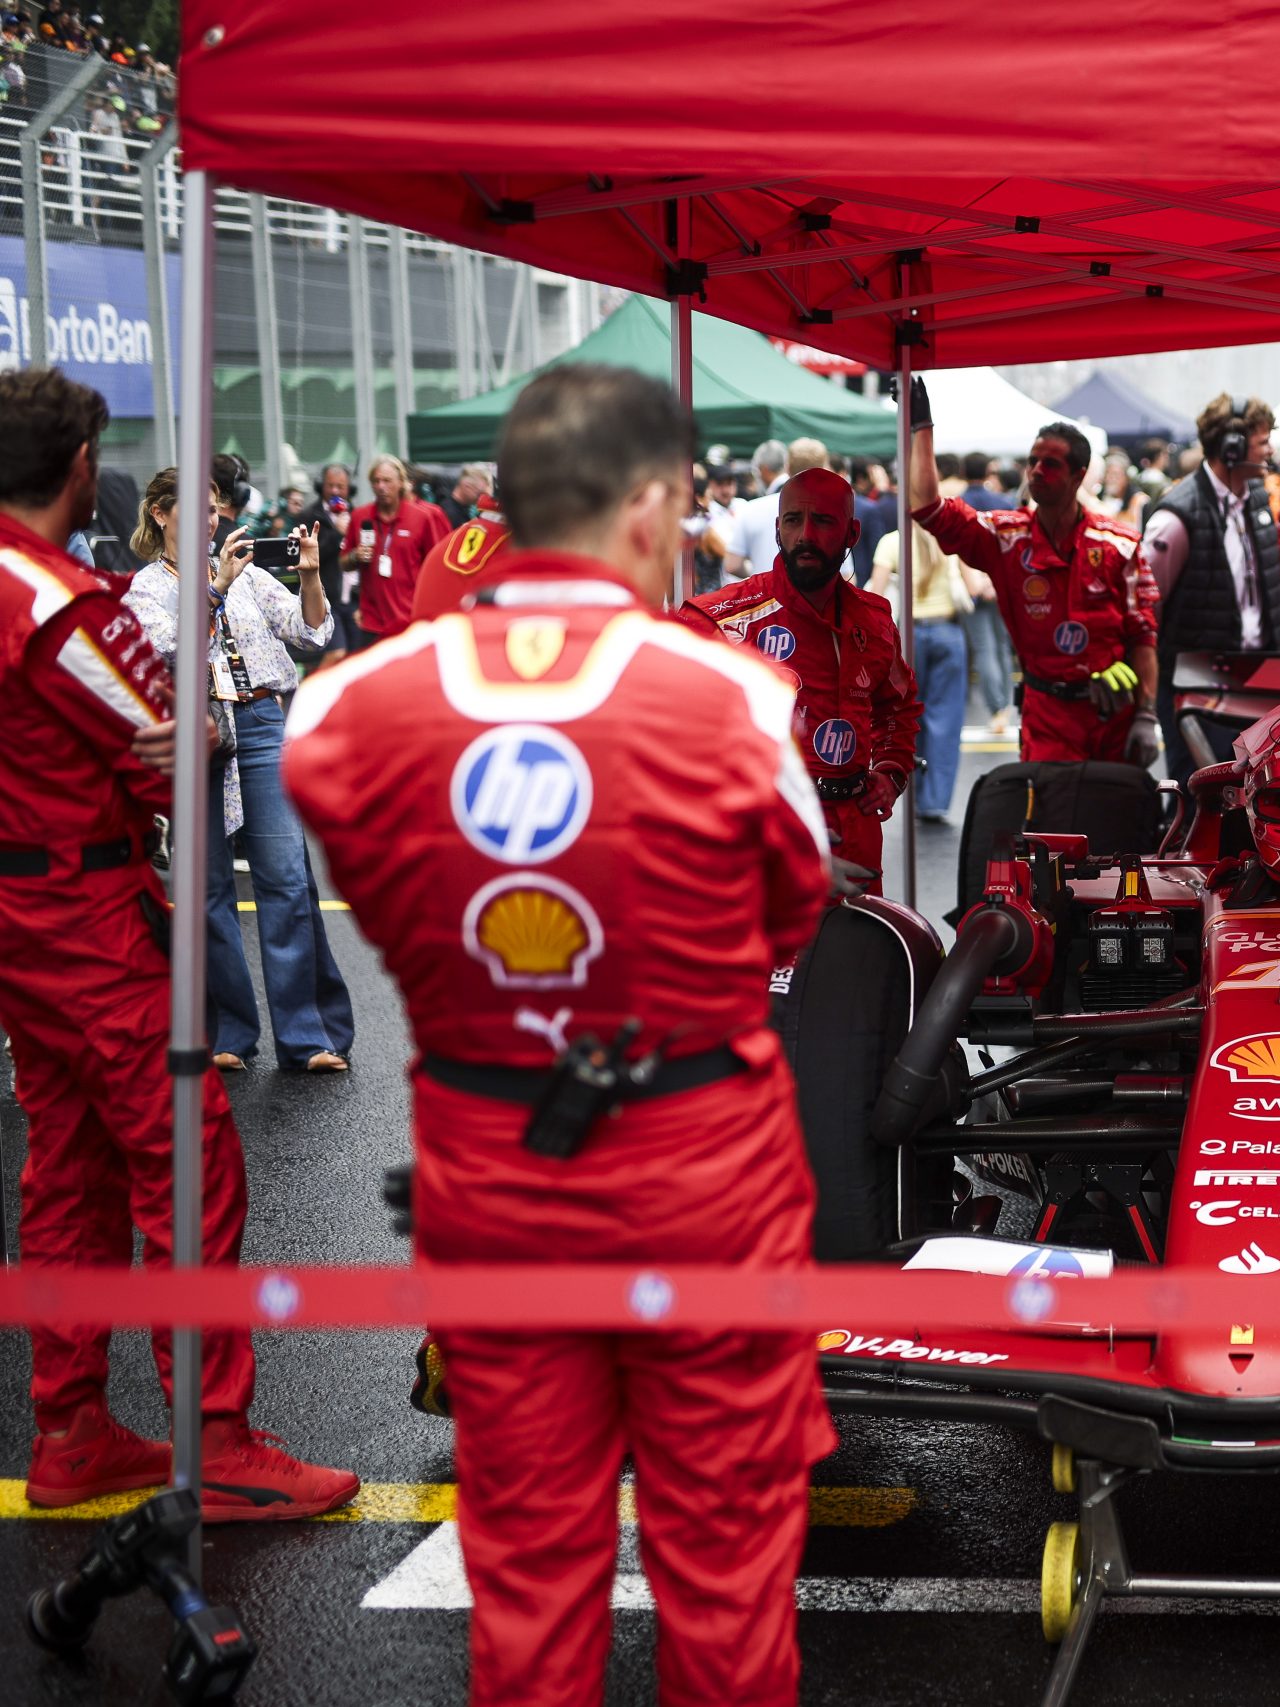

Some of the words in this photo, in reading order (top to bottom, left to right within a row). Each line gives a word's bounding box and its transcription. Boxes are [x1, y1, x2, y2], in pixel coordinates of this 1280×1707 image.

[759, 626, 795, 661] hp
[1054, 620, 1089, 655] hp
[816, 719, 856, 765] hp
[452, 722, 594, 864] hp
[844, 1336, 1009, 1364] V-Power
